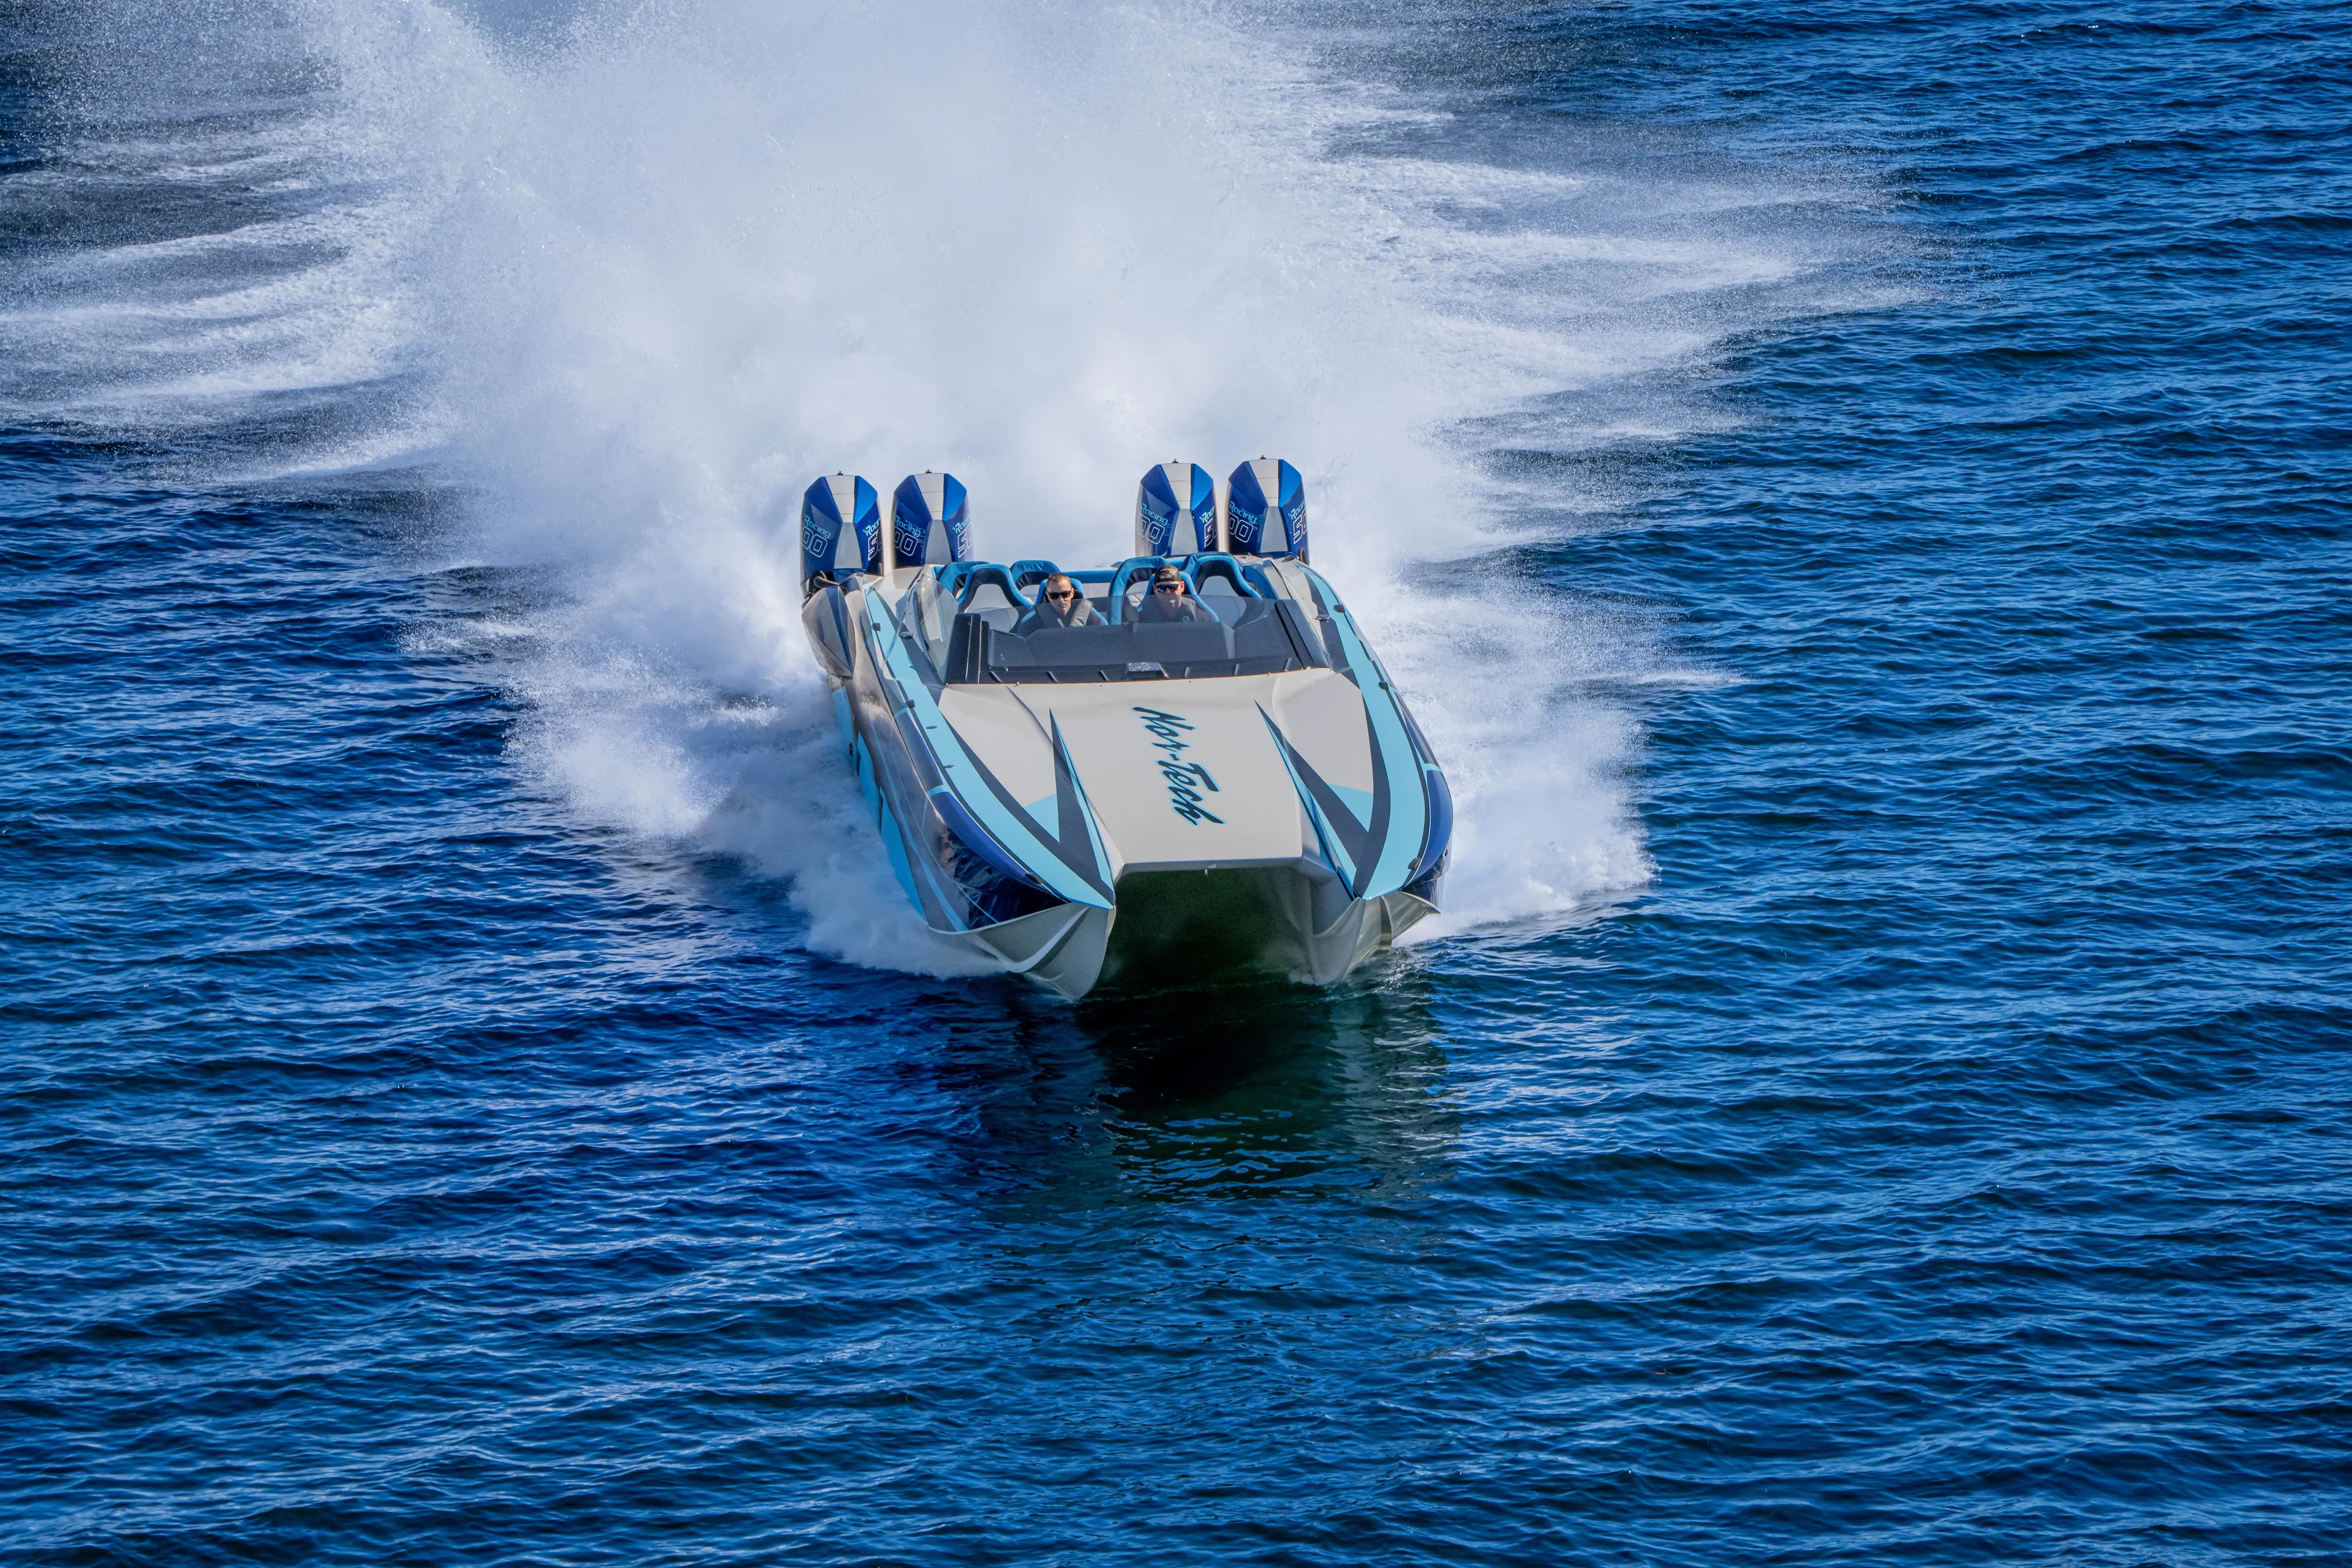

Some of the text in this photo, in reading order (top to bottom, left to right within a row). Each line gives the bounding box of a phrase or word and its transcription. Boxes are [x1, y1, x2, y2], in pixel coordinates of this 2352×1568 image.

[1141, 503, 1168, 526] Racing
[1229, 500, 1257, 524] Racing
[804, 513, 831, 539] Racing
[894, 514, 921, 537] Racing
[1131, 706, 1226, 826] Nor-Tech
